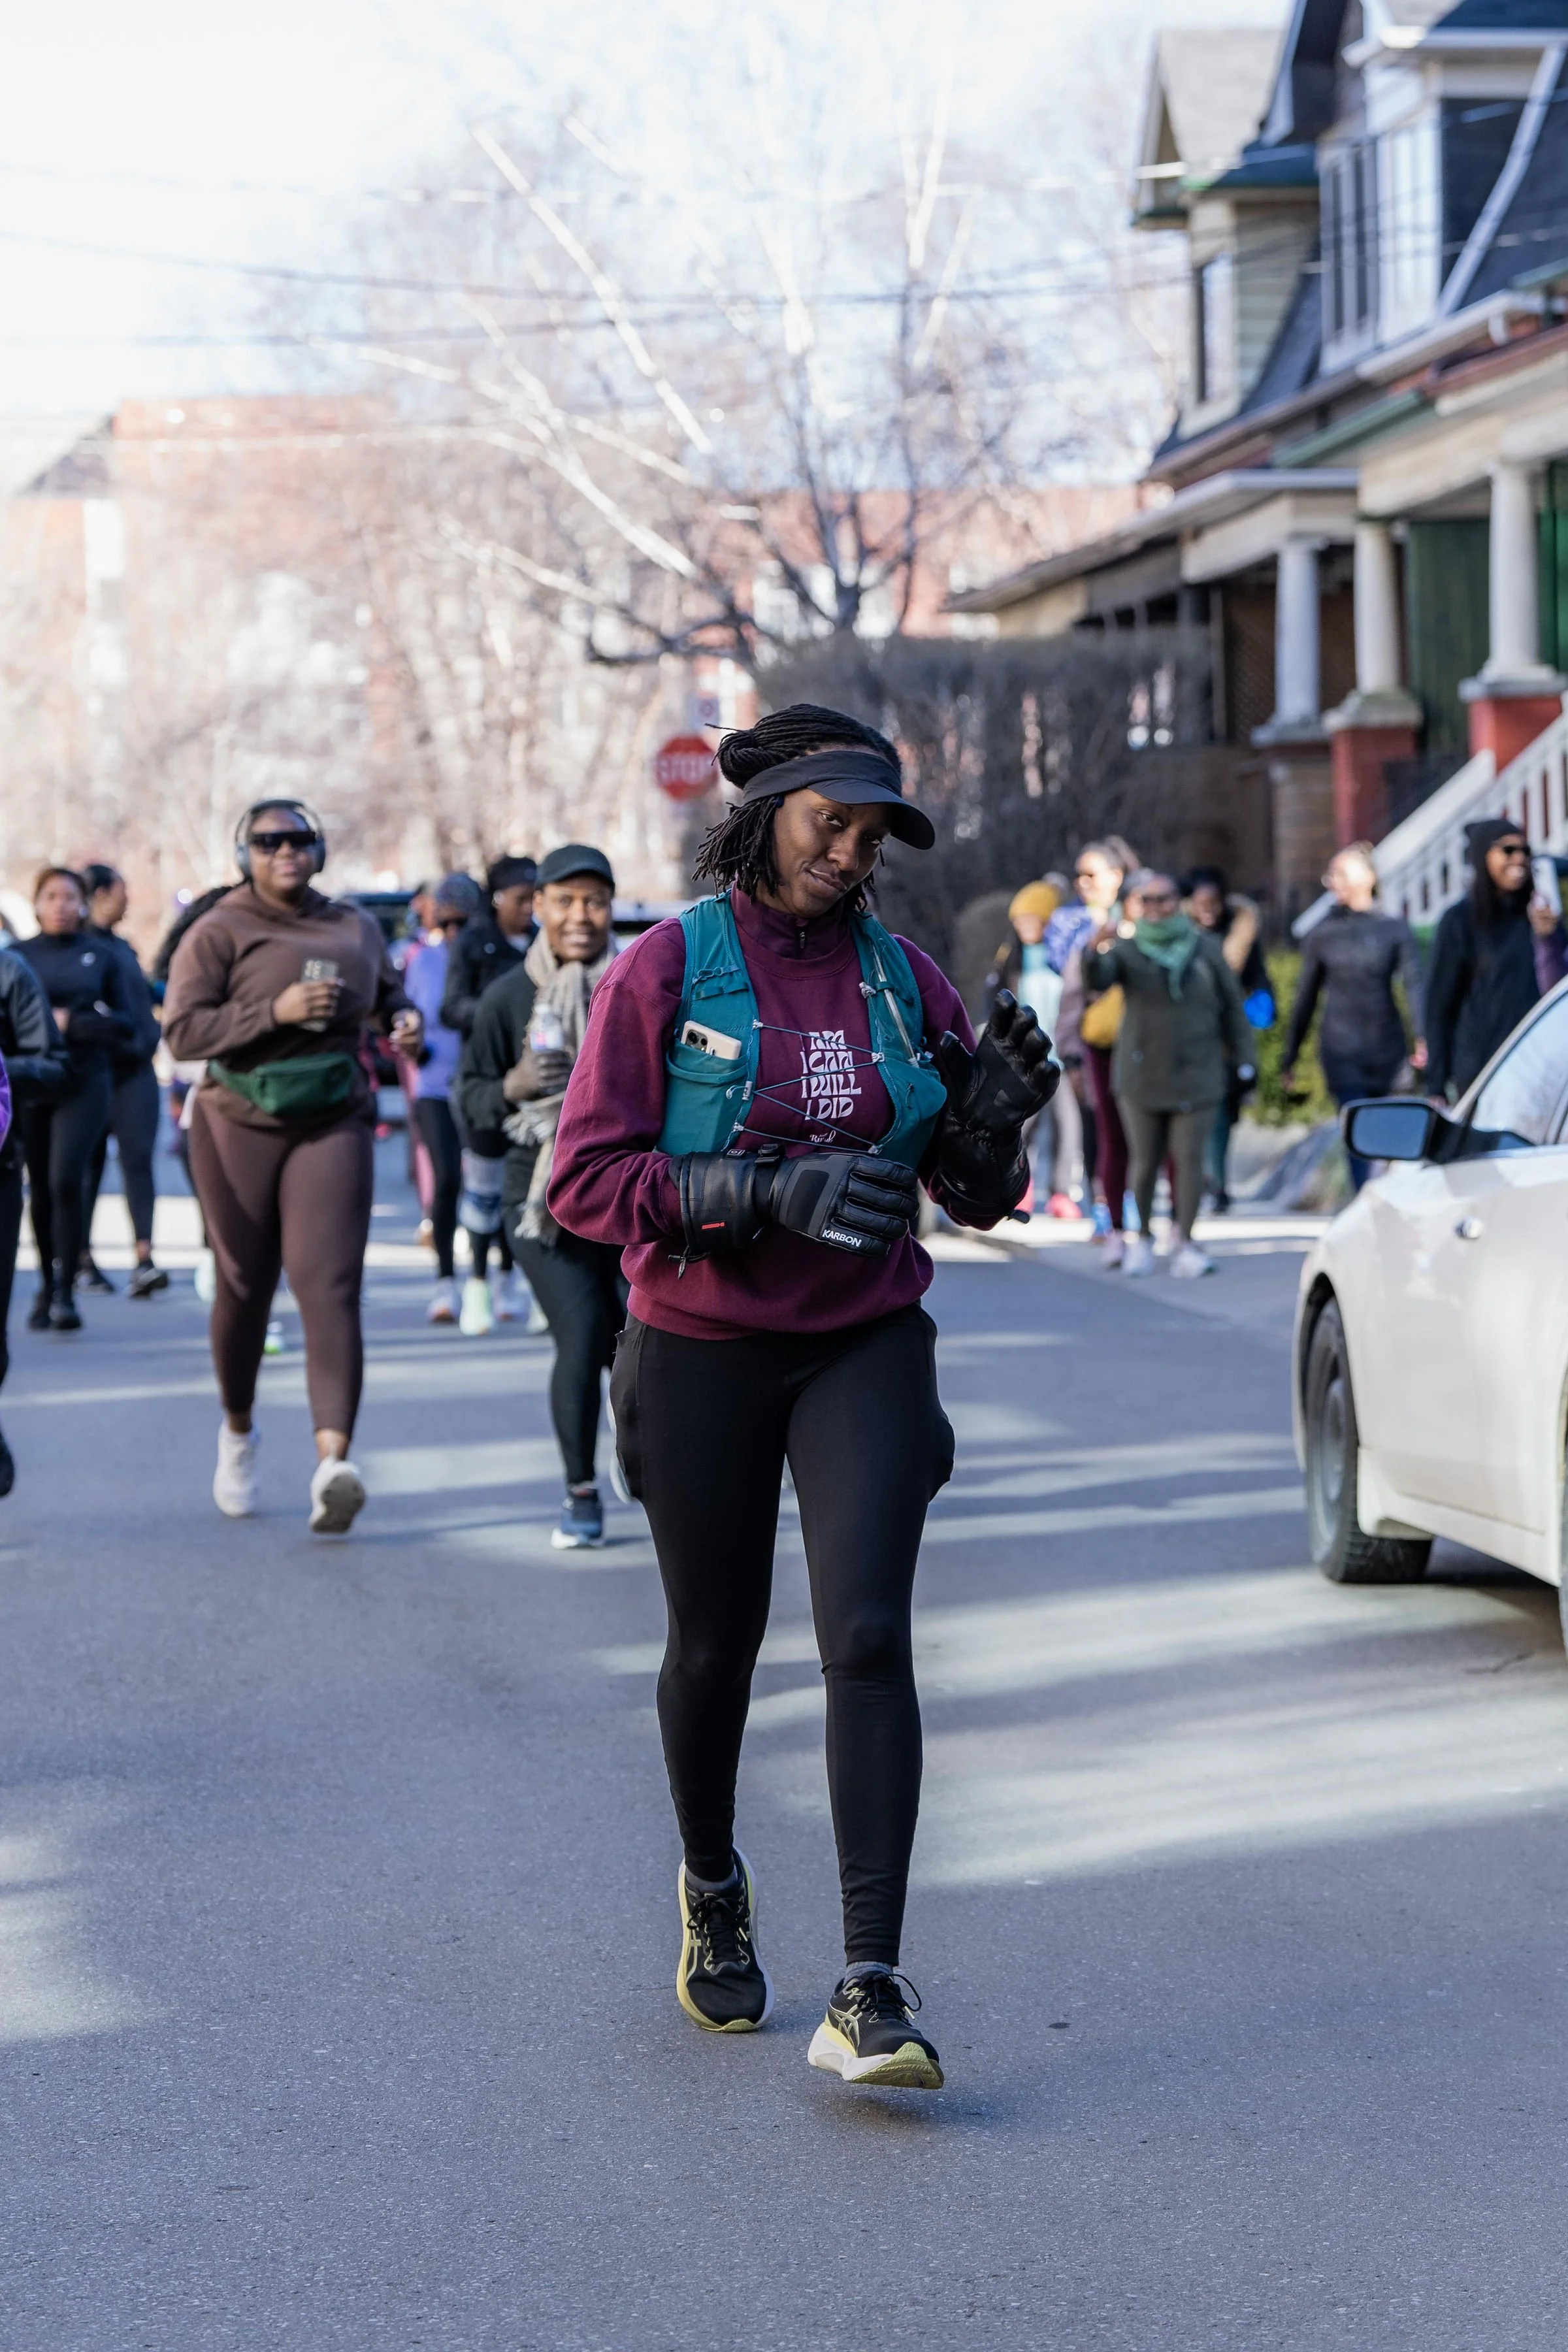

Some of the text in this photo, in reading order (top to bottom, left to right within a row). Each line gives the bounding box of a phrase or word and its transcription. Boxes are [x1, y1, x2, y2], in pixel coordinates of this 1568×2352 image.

[657, 753, 714, 783] STOP
[809, 1030, 847, 1051] AM
[800, 1051, 855, 1073] I CAN
[800, 1073, 861, 1098] I WILL
[804, 1097, 853, 1120] I DID
[822, 1229, 862, 1247] KARBON
